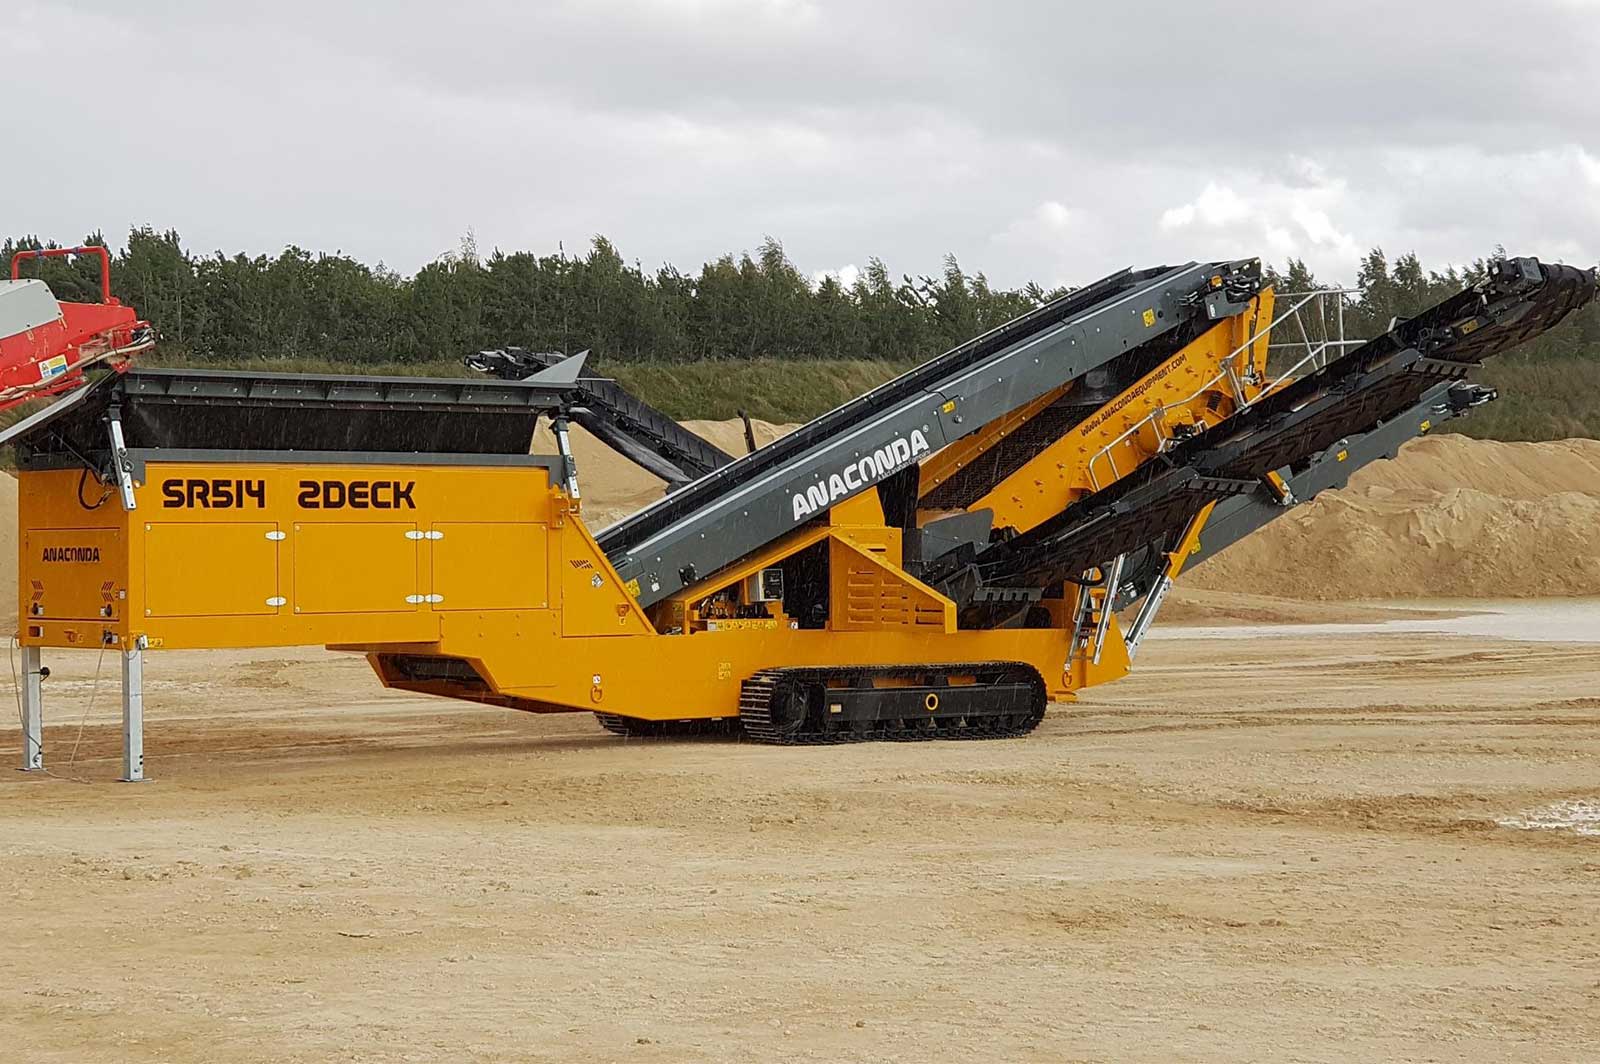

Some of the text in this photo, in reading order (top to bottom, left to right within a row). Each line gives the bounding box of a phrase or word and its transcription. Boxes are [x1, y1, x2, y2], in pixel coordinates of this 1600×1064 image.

[162, 479, 416, 509] SR514 2DECK
[42, 547, 100, 562] ANACONDA
